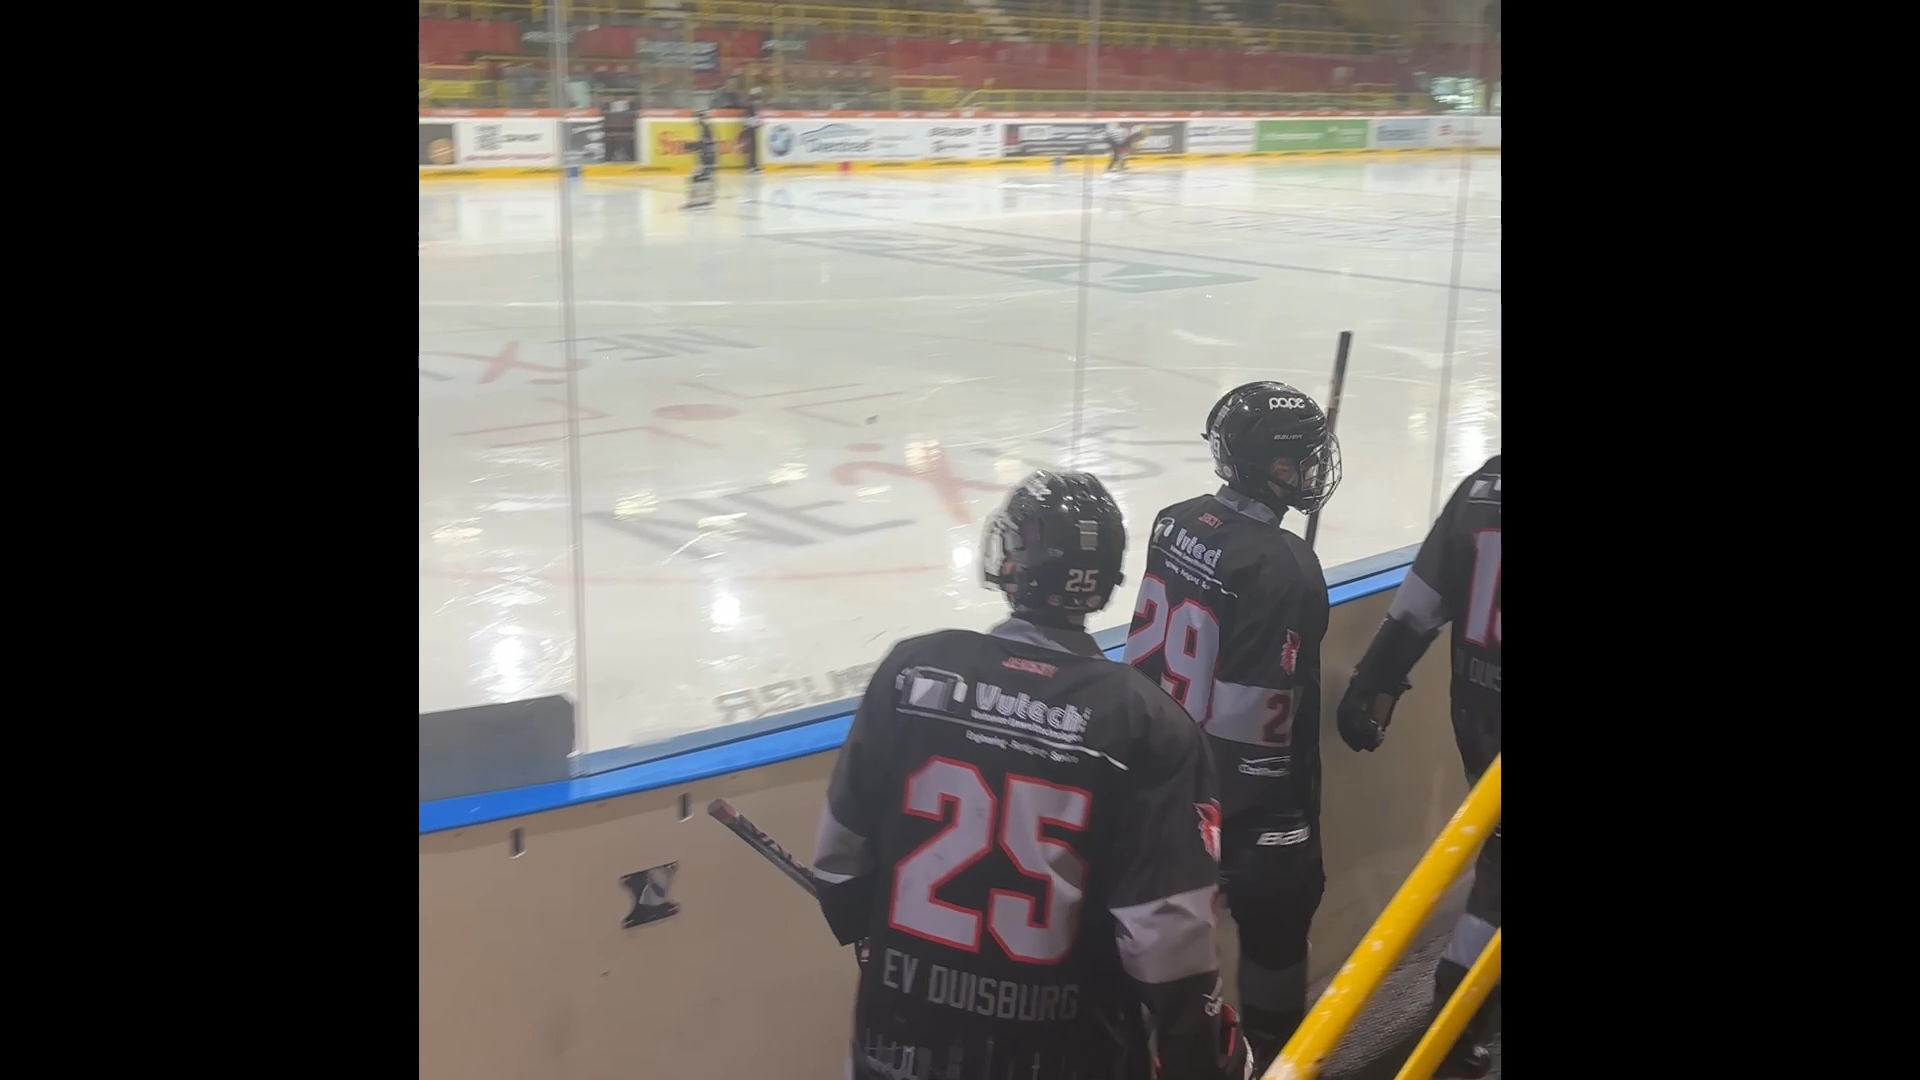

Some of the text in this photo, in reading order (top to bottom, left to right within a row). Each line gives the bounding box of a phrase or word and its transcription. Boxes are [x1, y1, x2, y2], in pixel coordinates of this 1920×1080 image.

[1269, 397, 1306, 410] pape
[1065, 568, 1099, 593] 25
[1123, 573, 1220, 728] 29
[975, 681, 1084, 733] Vutech
[888, 754, 1093, 966] 25
[883, 947, 1079, 1021] EV DUISBURG
